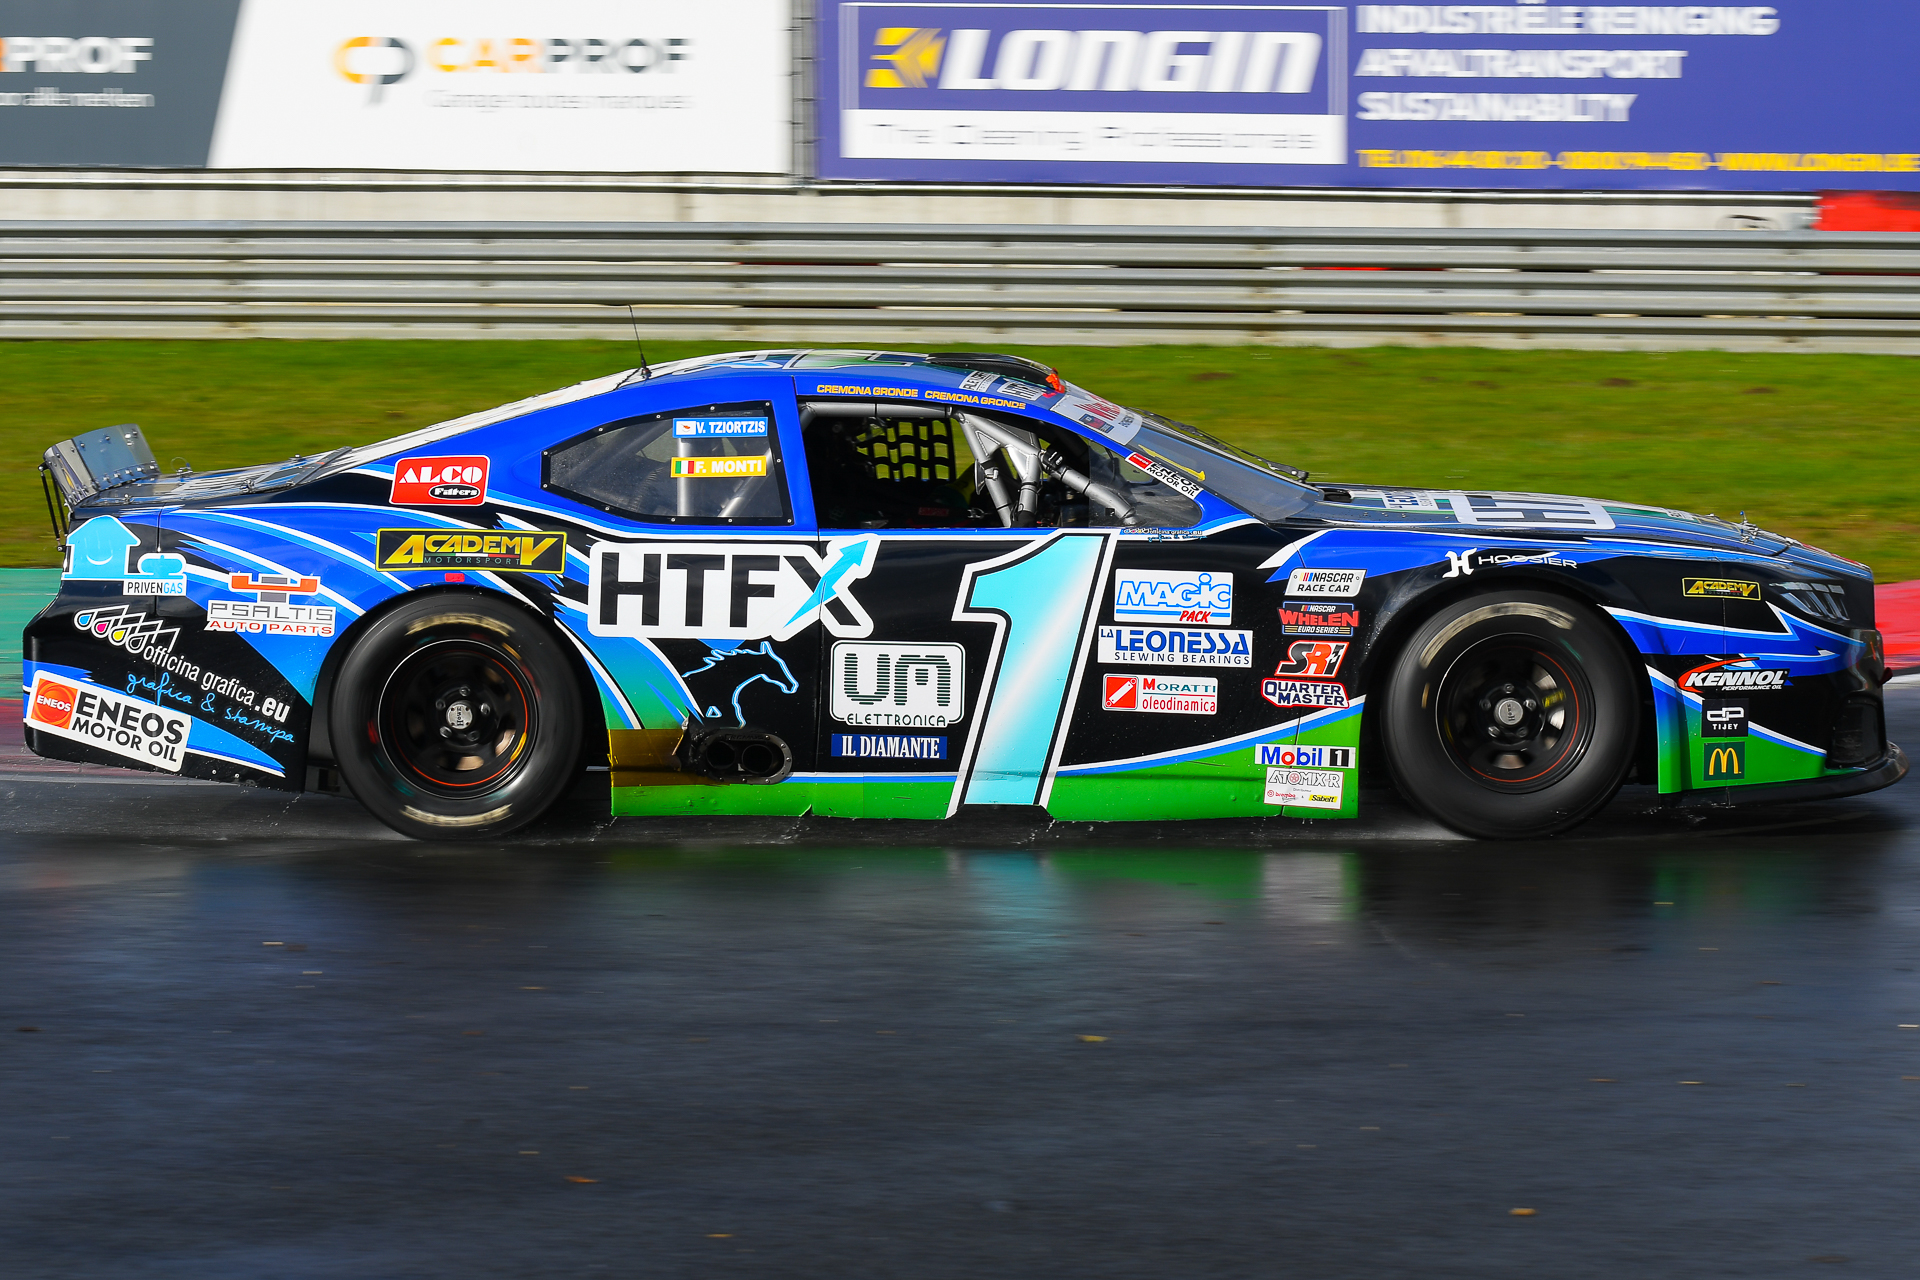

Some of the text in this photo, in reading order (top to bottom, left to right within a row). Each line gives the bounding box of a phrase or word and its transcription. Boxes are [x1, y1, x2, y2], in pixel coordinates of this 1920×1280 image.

[425, 38, 692, 74] CARPROF
[938, 29, 1323, 94] LONGIN
[817, 384, 919, 398] CREMONA GRONDE
[924, 390, 1027, 410] CREMONA GRONDE
[696, 420, 766, 434] V. TZIORTZIS
[398, 465, 484, 484] ALCO
[695, 459, 762, 474] F. MONTI
[1146, 466, 1196, 498] MOTOR OIL
[1150, 462, 1201, 491] ENEOS
[383, 534, 560, 566] ACADEMY
[423, 556, 521, 566] MOTORSPORT
[599, 540, 869, 629] HTFX
[1312, 572, 1354, 583] NASCAR
[127, 581, 184, 595] PRIVENGAS
[1296, 583, 1350, 593] RACE CAR
[1686, 580, 1756, 597] ACADEMY
[210, 602, 334, 621] PSALTIS
[1179, 610, 1211, 624] PACK
[1309, 604, 1337, 613] NASCAR
[1278, 608, 1360, 628] WHELEN
[208, 620, 333, 635] AUTO PARTS
[1297, 625, 1340, 634] EURO SERIES
[1100, 628, 1250, 656] LA LEONESSA
[142, 644, 201, 682] officina
[1114, 652, 1250, 665] SLEWING BEARINGS
[843, 652, 952, 707] UM
[946, 529, 1121, 818] 1
[1684, 670, 1786, 687] KENNOL
[1142, 677, 1216, 693] MORATTI
[1264, 680, 1342, 697] QUARTER
[36, 694, 72, 712] ENEOS
[126, 672, 296, 743] grafica & stampa
[1142, 695, 1216, 712] oleodinamica
[1277, 692, 1345, 706] MASTER
[75, 690, 185, 745] ENEOS
[846, 713, 946, 727] ELETTRONICA
[71, 716, 178, 763] MOTOR OIL
[841, 735, 940, 759] IL DIAMANTE
[1261, 745, 1323, 766] Mobil
